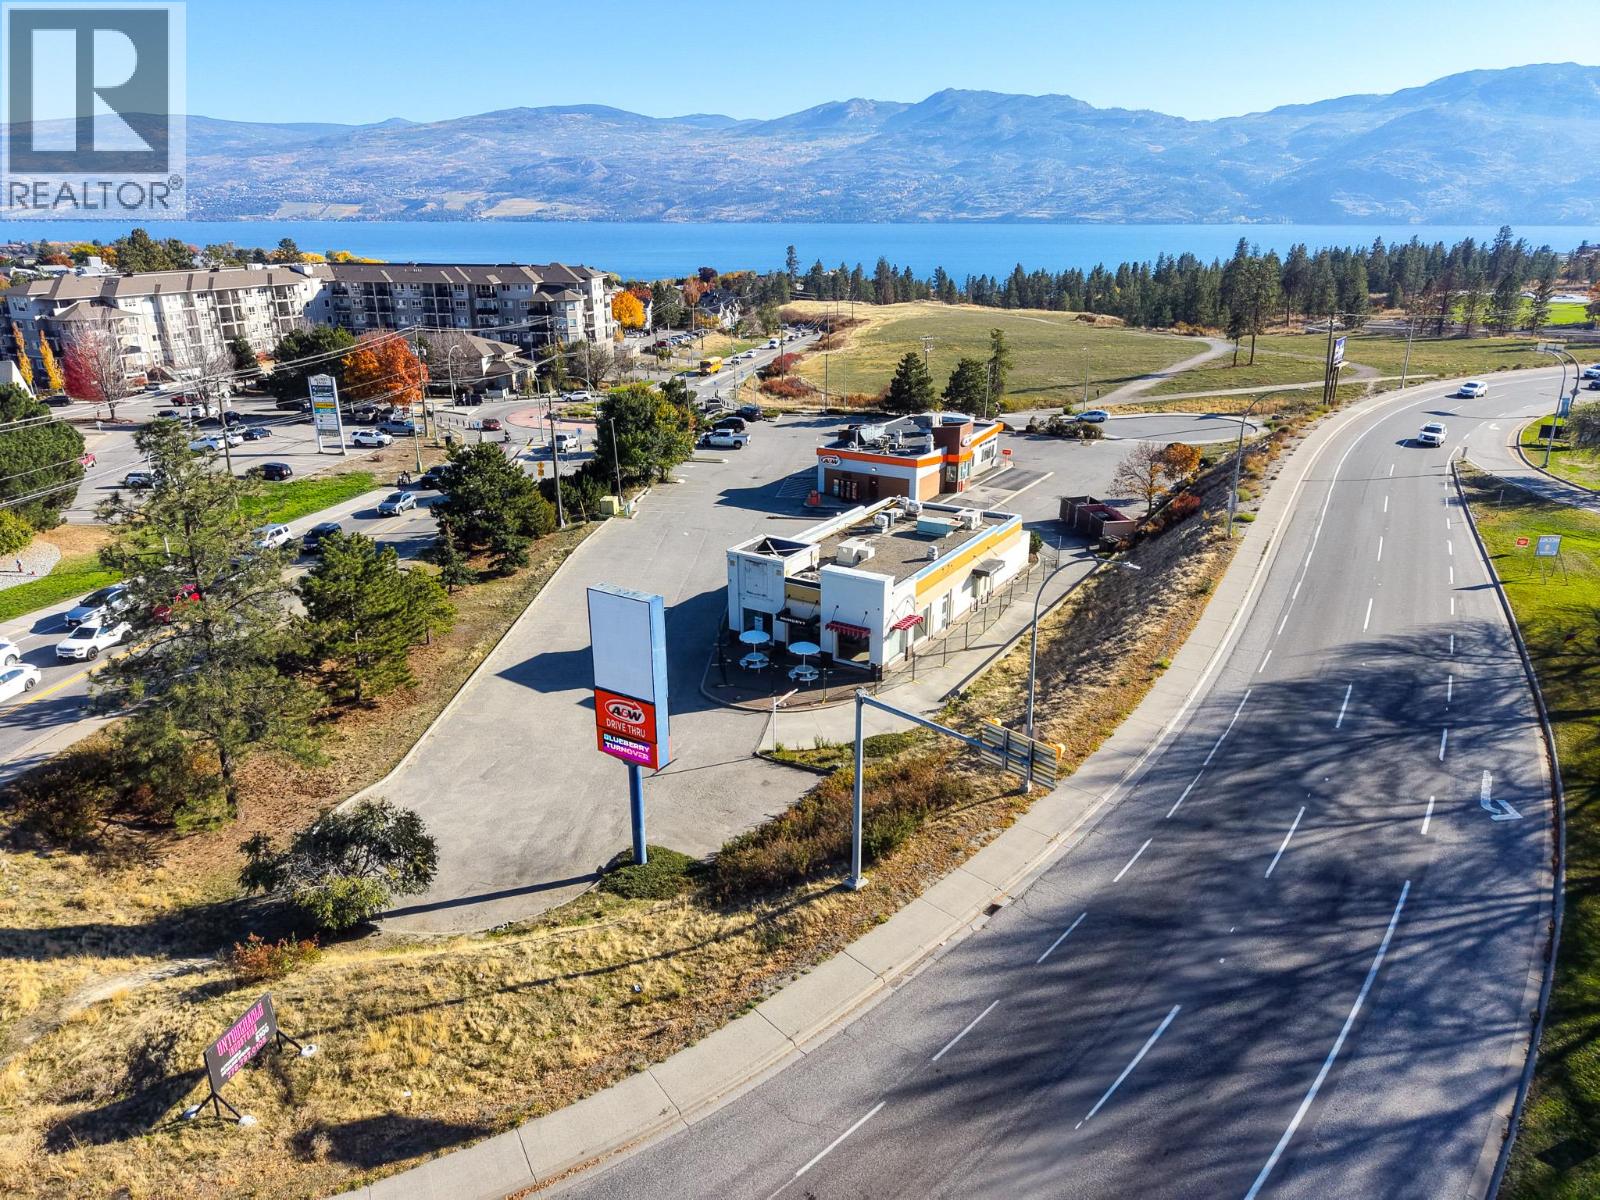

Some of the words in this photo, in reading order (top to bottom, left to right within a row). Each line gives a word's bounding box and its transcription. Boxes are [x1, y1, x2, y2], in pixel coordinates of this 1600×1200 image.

[612, 706, 642, 721] A&W
[606, 718, 627, 732] DRIVE
[627, 725, 646, 738] THRU
[603, 733, 650, 753] BLUEBERRY
[605, 742, 650, 761] TURNOVER
